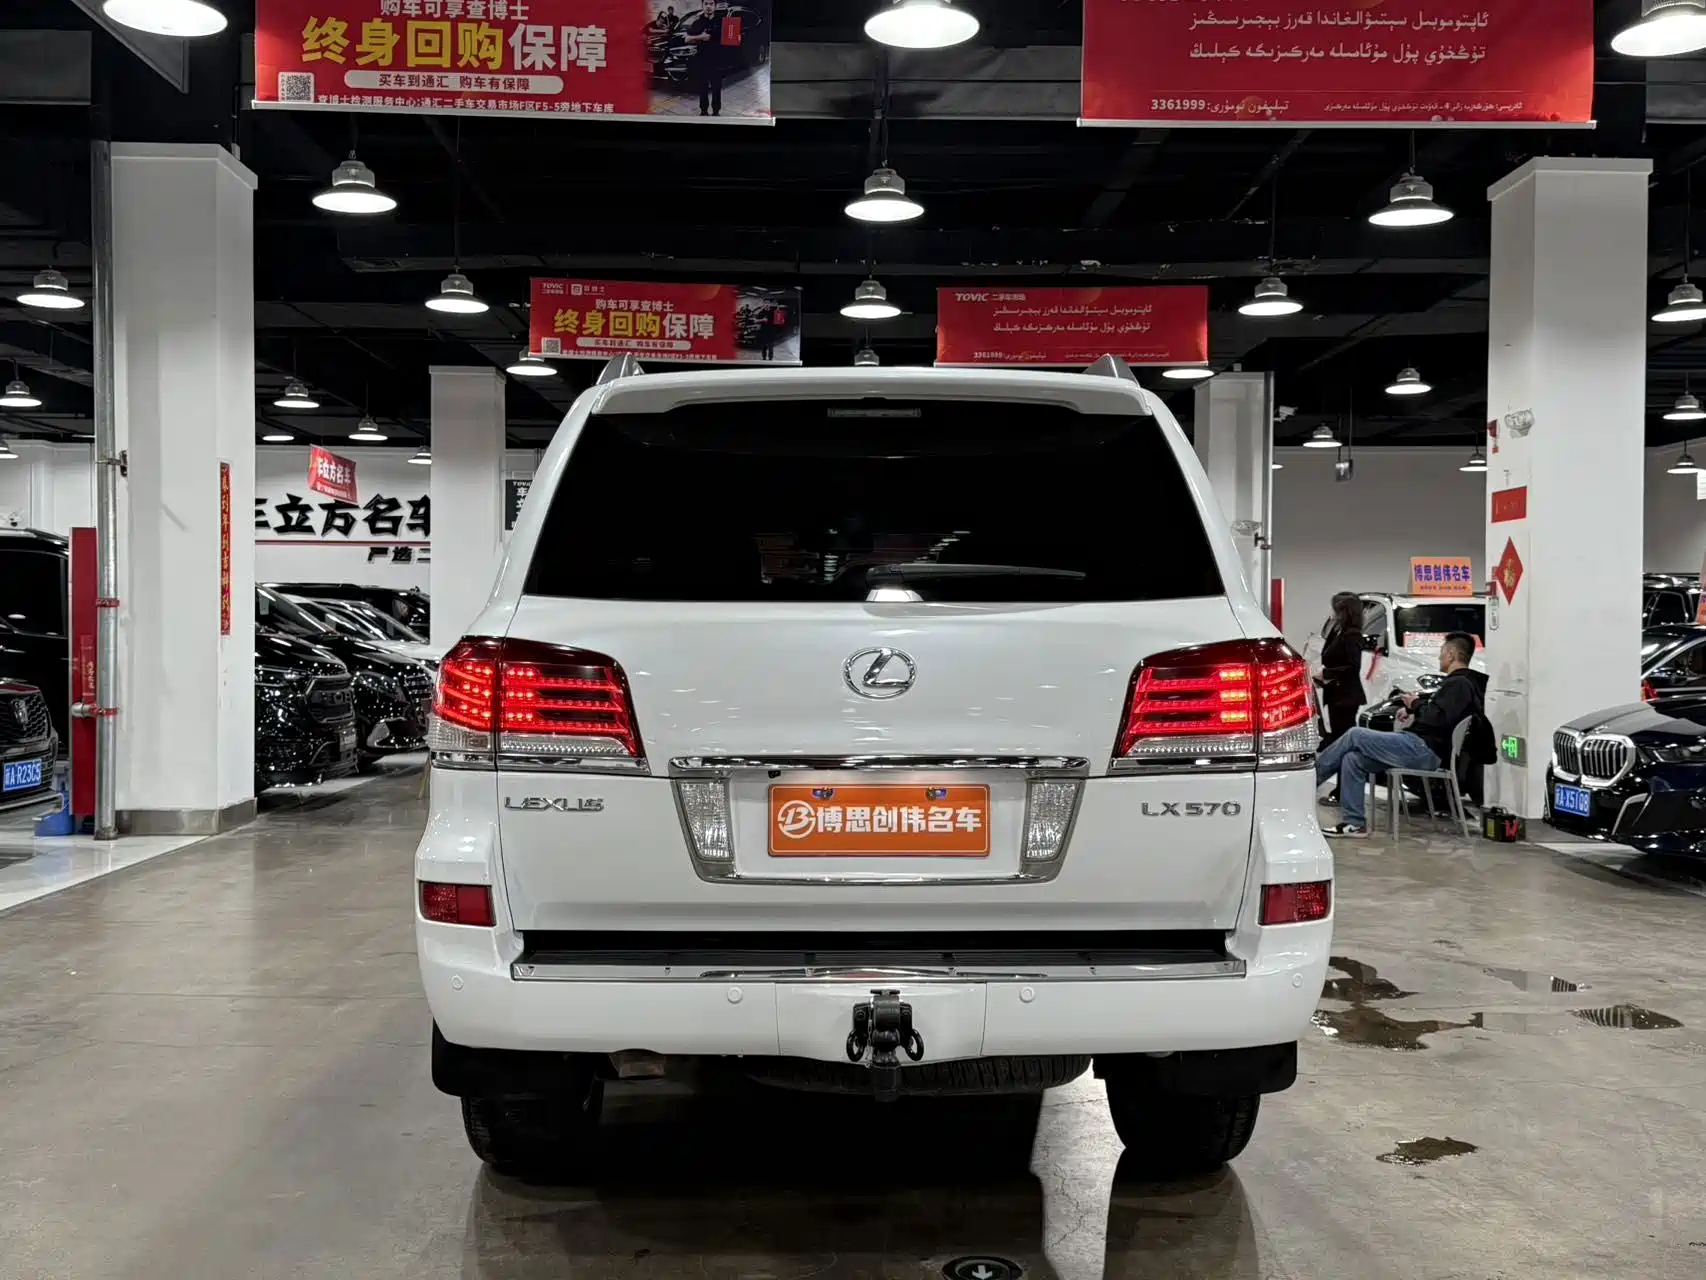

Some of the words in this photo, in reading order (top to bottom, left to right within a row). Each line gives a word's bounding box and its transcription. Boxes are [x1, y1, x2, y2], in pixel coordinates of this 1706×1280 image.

[380, 0, 530, 21] 购车可享查博士
[302, 16, 607, 73] 终身回购保障
[379, 73, 449, 89] 买车到通汇
[459, 75, 530, 92] 购车有保障
[595, 298, 674, 313] 购车可享查博士
[955, 292, 989, 302] TOVIC
[554, 308, 715, 340] 终身回购保障
[504, 796, 605, 812] LEXUS
[1141, 802, 1180, 817] LX
[1184, 801, 1242, 817] 570
[816, 805, 983, 834] 博思创伟名车
